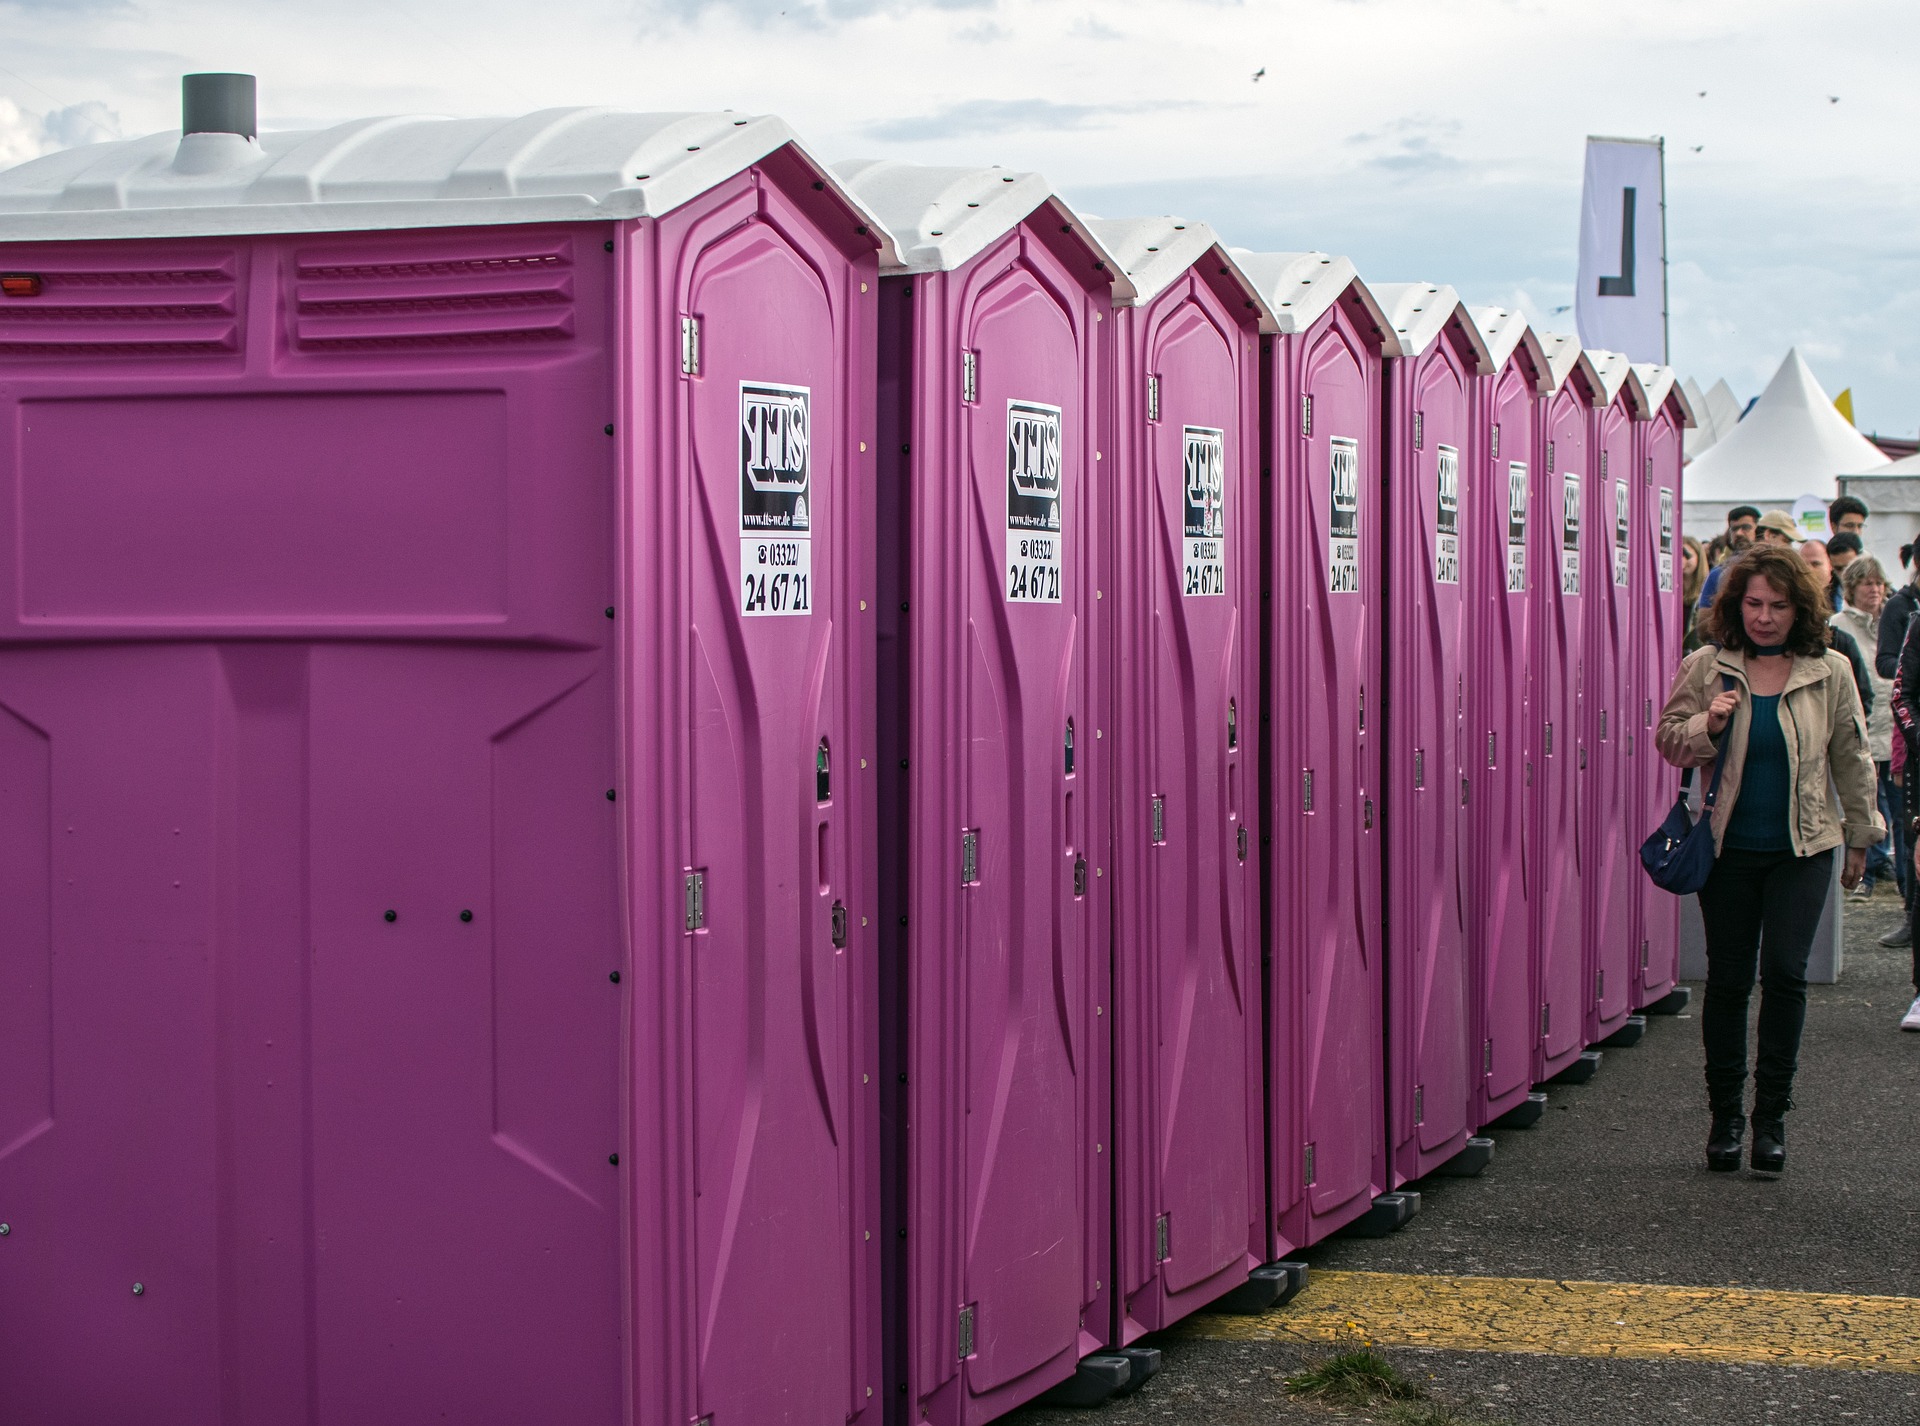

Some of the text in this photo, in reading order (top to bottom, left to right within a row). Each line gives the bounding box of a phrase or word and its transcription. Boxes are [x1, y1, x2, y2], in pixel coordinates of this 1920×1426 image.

[743, 511, 790, 527] www.tts-wc.de
[745, 573, 808, 611] 24 67 21
[1010, 565, 1060, 599] 24 67 21
[1186, 565, 1223, 594] 24 67 21
[1331, 564, 1341, 591] 24
[1342, 564, 1350, 591] 67
